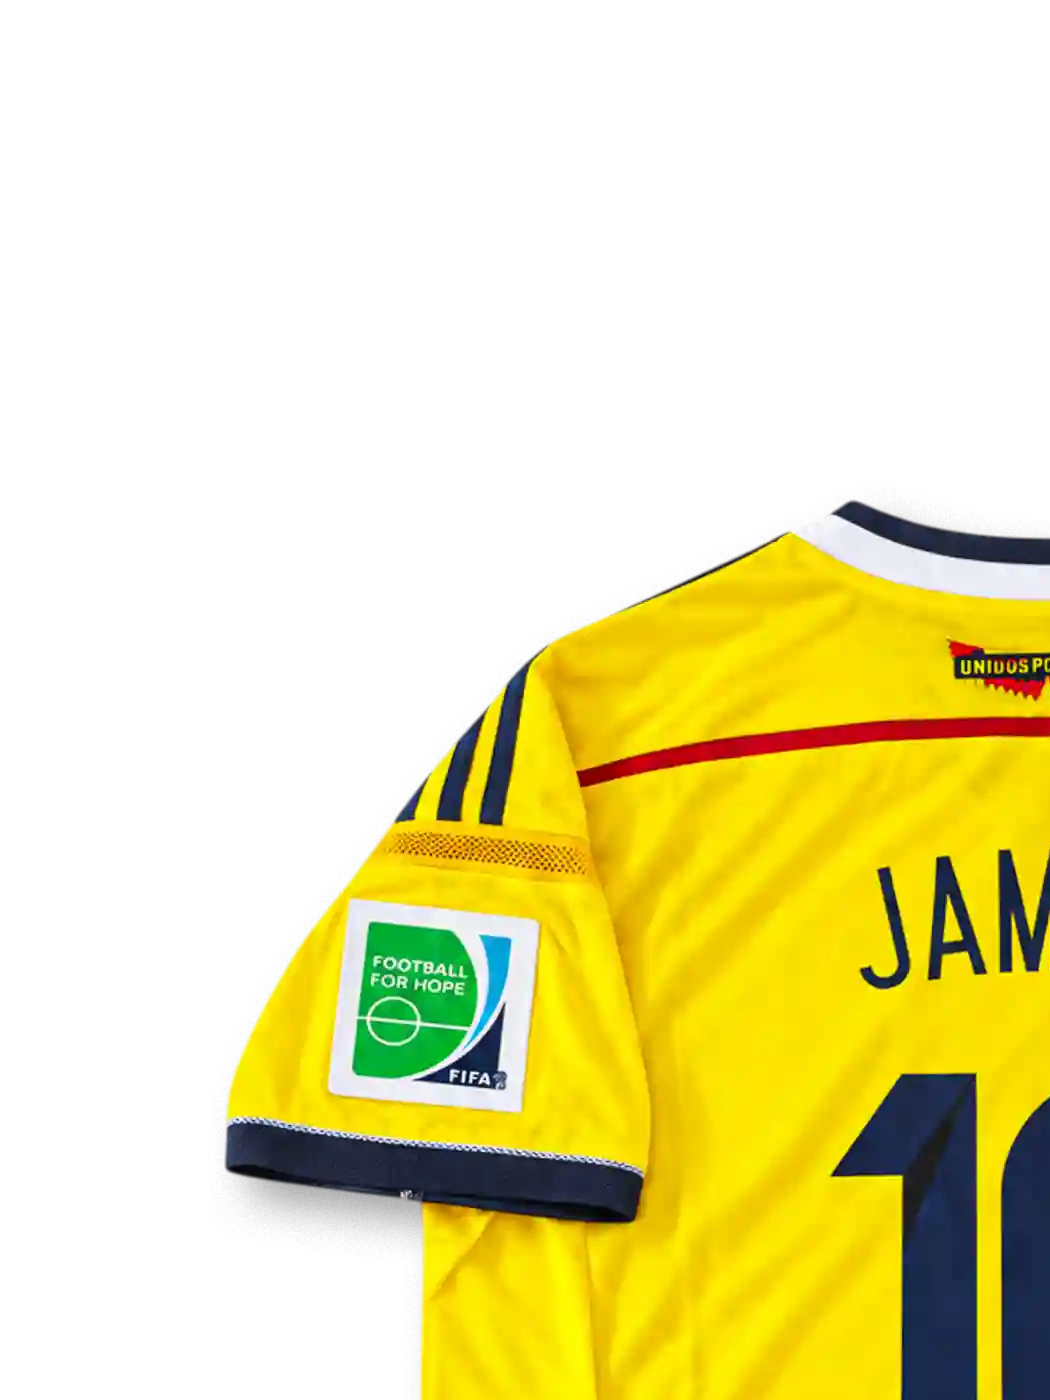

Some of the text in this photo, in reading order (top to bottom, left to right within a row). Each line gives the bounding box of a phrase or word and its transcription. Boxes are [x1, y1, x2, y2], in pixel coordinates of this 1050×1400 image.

[372, 955, 468, 978] FOOTBALL
[370, 973, 465, 995] FOR HOPE
[449, 1068, 491, 1086] FIFA
